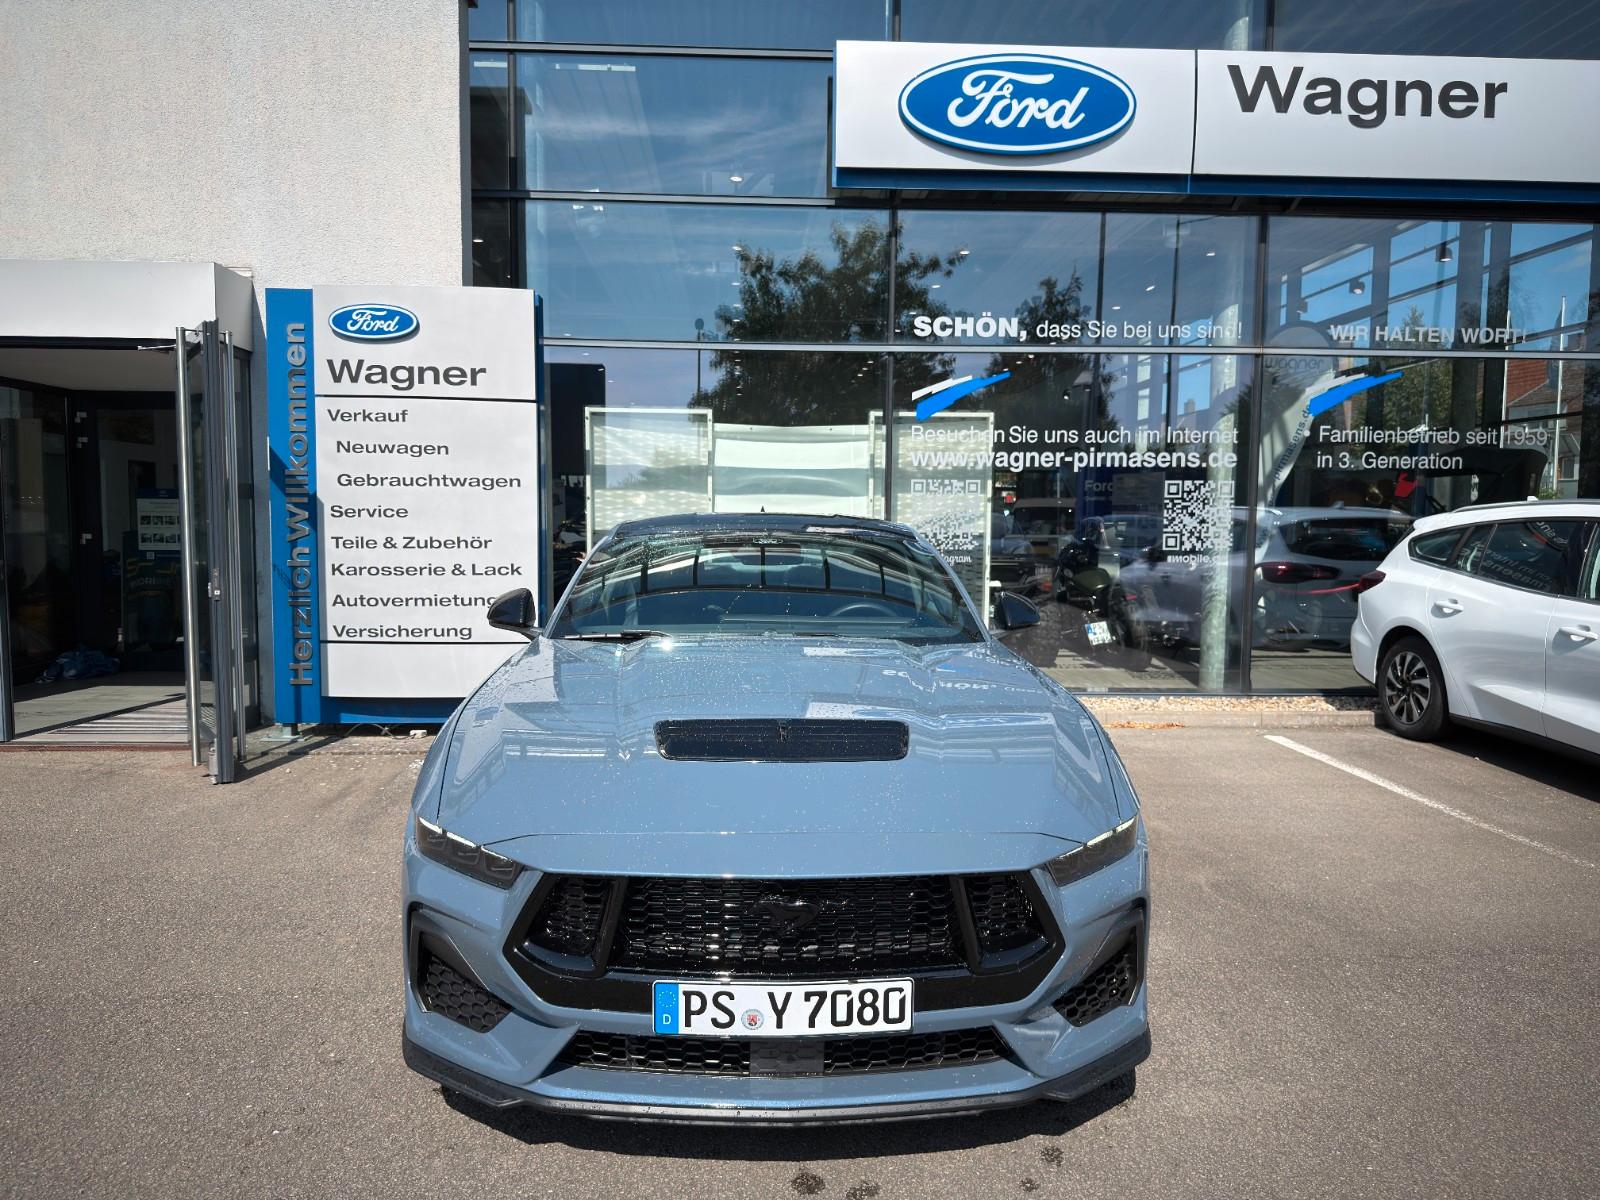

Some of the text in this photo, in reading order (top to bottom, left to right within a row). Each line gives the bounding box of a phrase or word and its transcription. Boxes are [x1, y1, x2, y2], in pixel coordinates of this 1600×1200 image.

[946, 69, 1091, 131] Ford
[1227, 64, 1509, 128] Wagner
[346, 308, 399, 332] Ford
[913, 311, 1028, 342] SCHÖN,
[1036, 322, 1082, 339] dass
[1087, 321, 1118, 339] Sie
[1124, 321, 1151, 339] bei
[1157, 325, 1191, 339] uns
[1329, 325, 1527, 345] WIR HALTEN WORT!
[327, 358, 487, 392] Wagner
[326, 408, 409, 423] Verkauf
[911, 425, 1239, 445] Besuchen Sie uns auch im Internet
[1319, 425, 1548, 446] Familienbetrieb seit 1959
[336, 440, 450, 458] Neuwagen
[910, 447, 1238, 472] www.wagner-pirmasens.de
[1316, 451, 1463, 470] in 3. Generation
[336, 473, 522, 491] Gebrauchtwagen
[284, 322, 313, 685] Herzlich Willkommen
[329, 504, 409, 518] Service
[330, 535, 493, 550] Teile & Zubehör
[330, 563, 523, 577] Karosserie & Lack
[332, 624, 473, 640] Versicherung
[682, 990, 736, 1030] PS
[767, 991, 792, 1030] Y
[804, 987, 906, 1029] 7080
[662, 1013, 672, 1025] D
